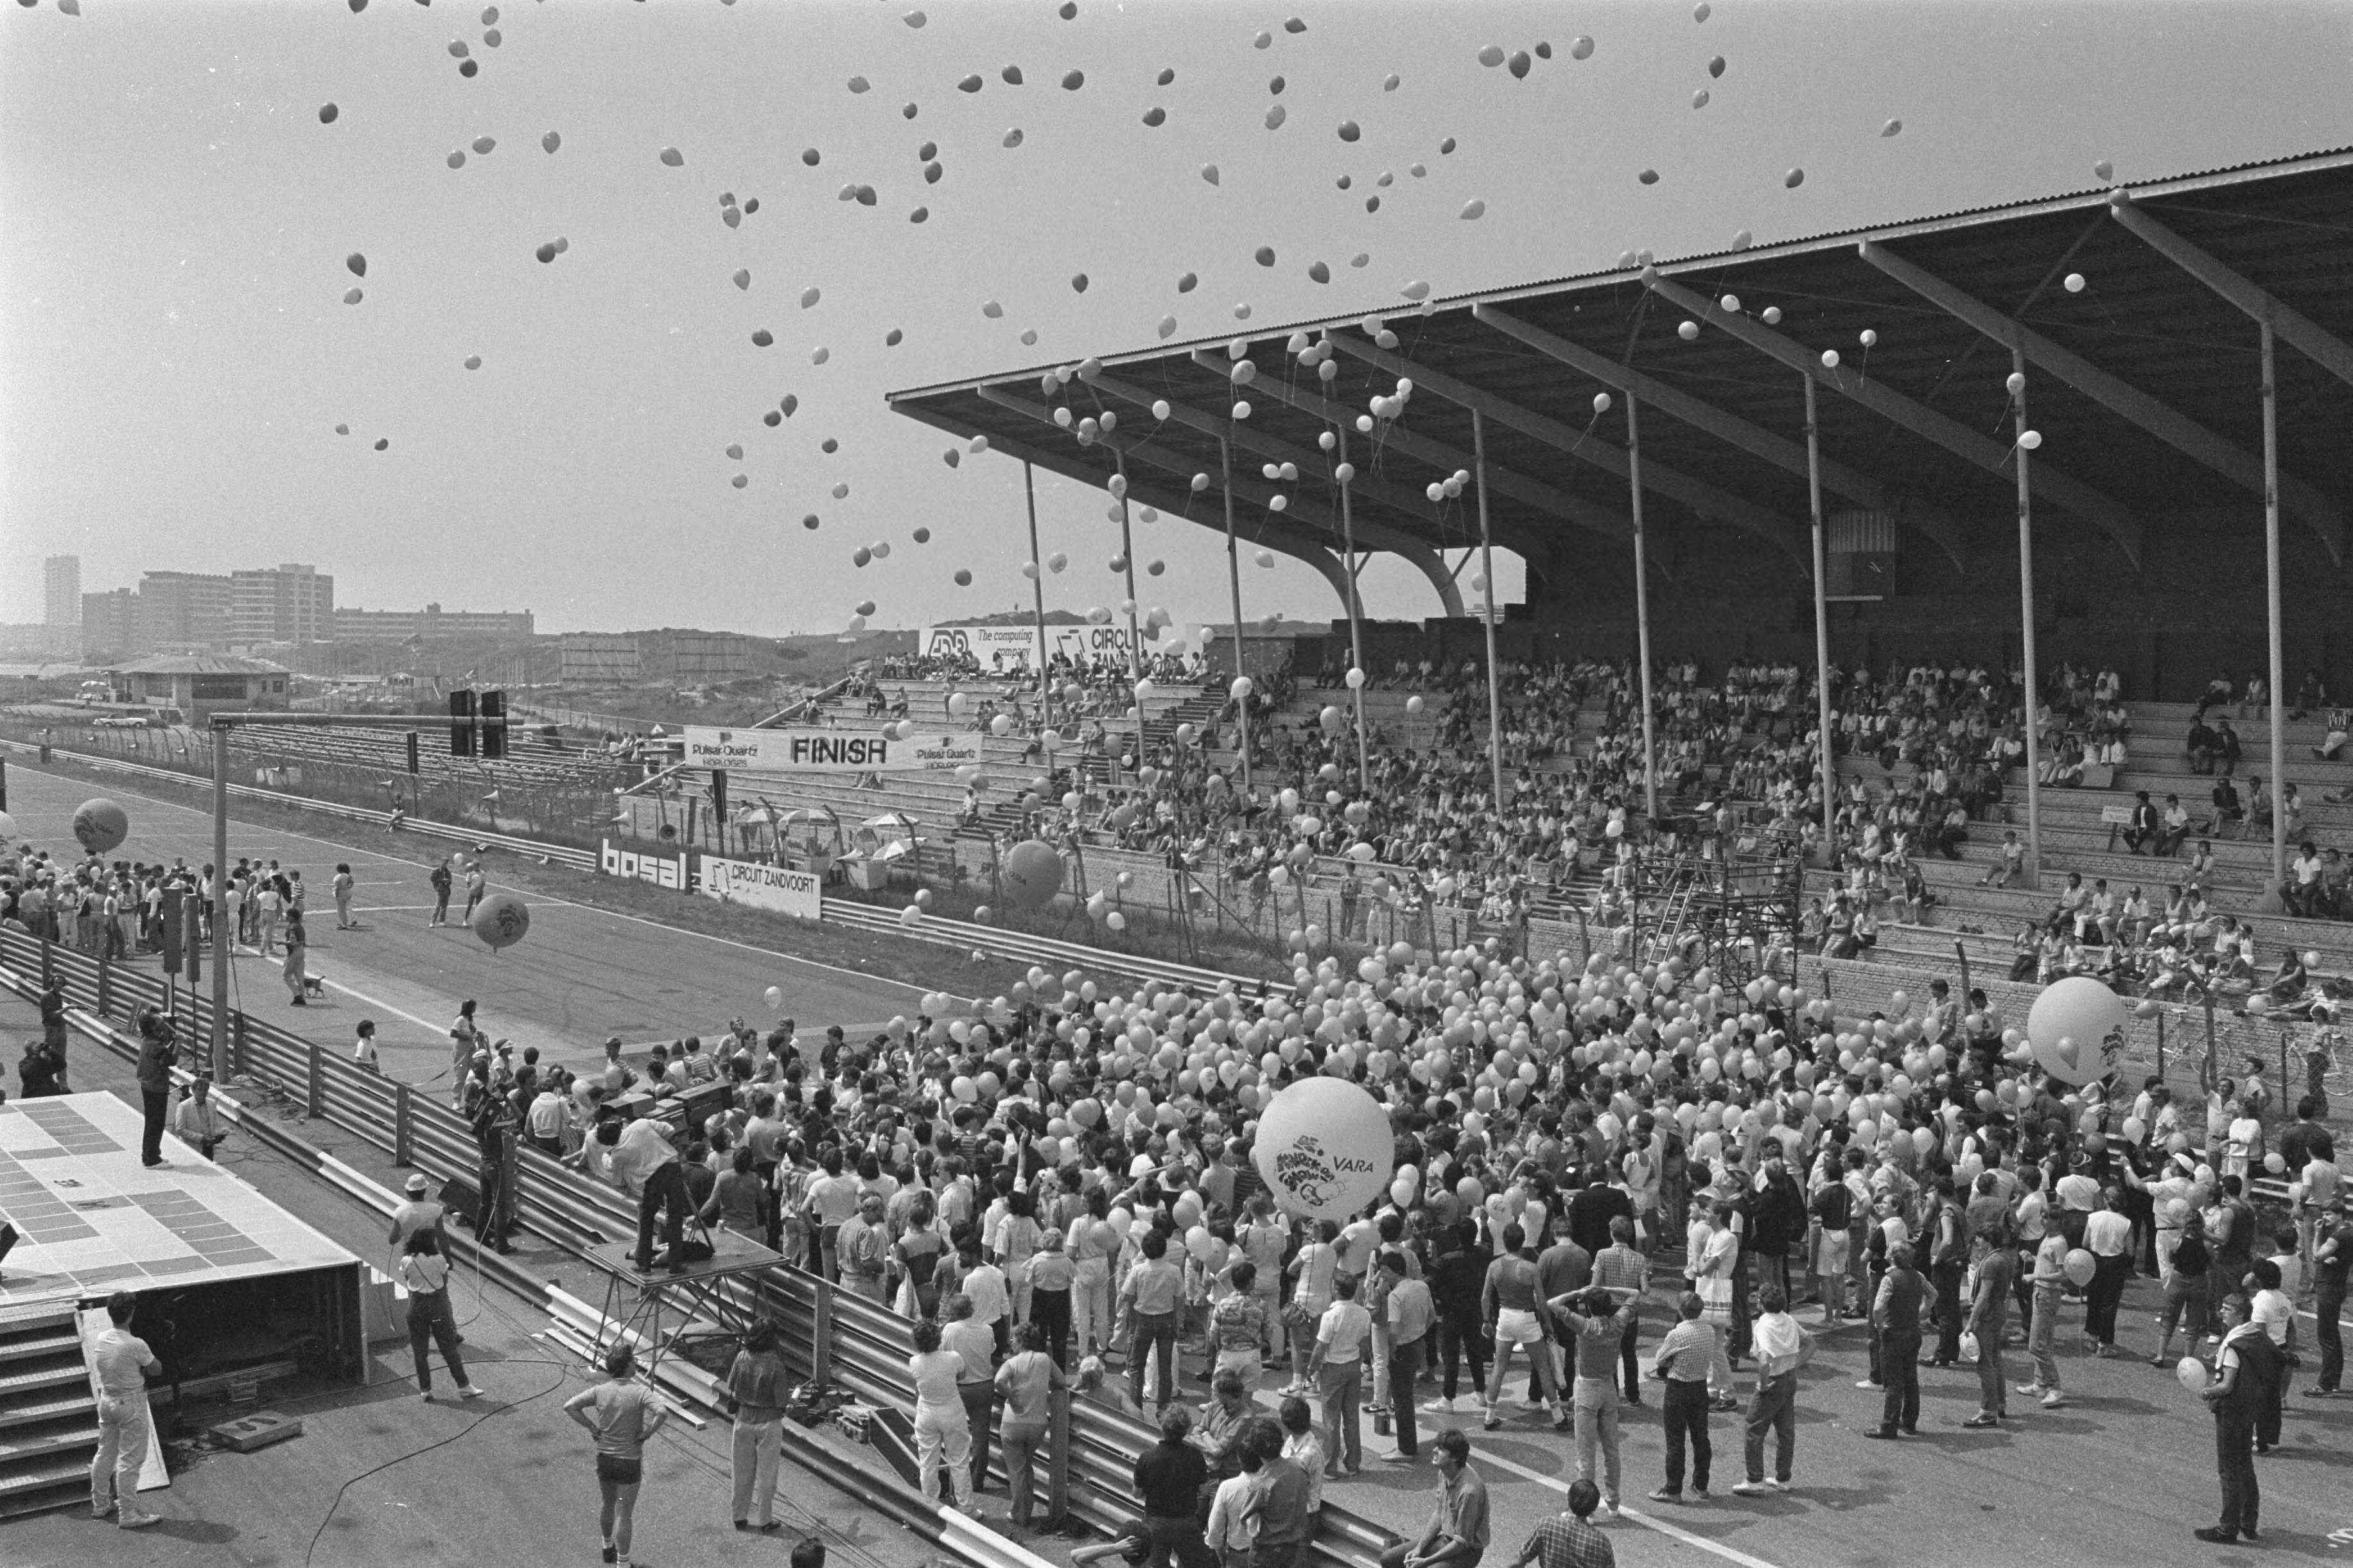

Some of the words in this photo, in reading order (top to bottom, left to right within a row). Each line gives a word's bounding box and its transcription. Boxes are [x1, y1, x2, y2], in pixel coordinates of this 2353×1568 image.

[979, 629, 992, 641] The
[994, 629, 1033, 643] computing
[1092, 628, 1144, 650] CIRCUT
[693, 744, 723, 755] Pulsar
[724, 744, 757, 756] Quartz
[792, 738, 887, 764] FINISH
[918, 749, 945, 760] Pulsar
[947, 749, 976, 759] Quartz
[602, 838, 686, 890] bosal
[731, 864, 763, 884] CIRCUIT
[765, 870, 815, 894] ZANDVOORT
[1334, 1156, 1373, 1172] VARA
